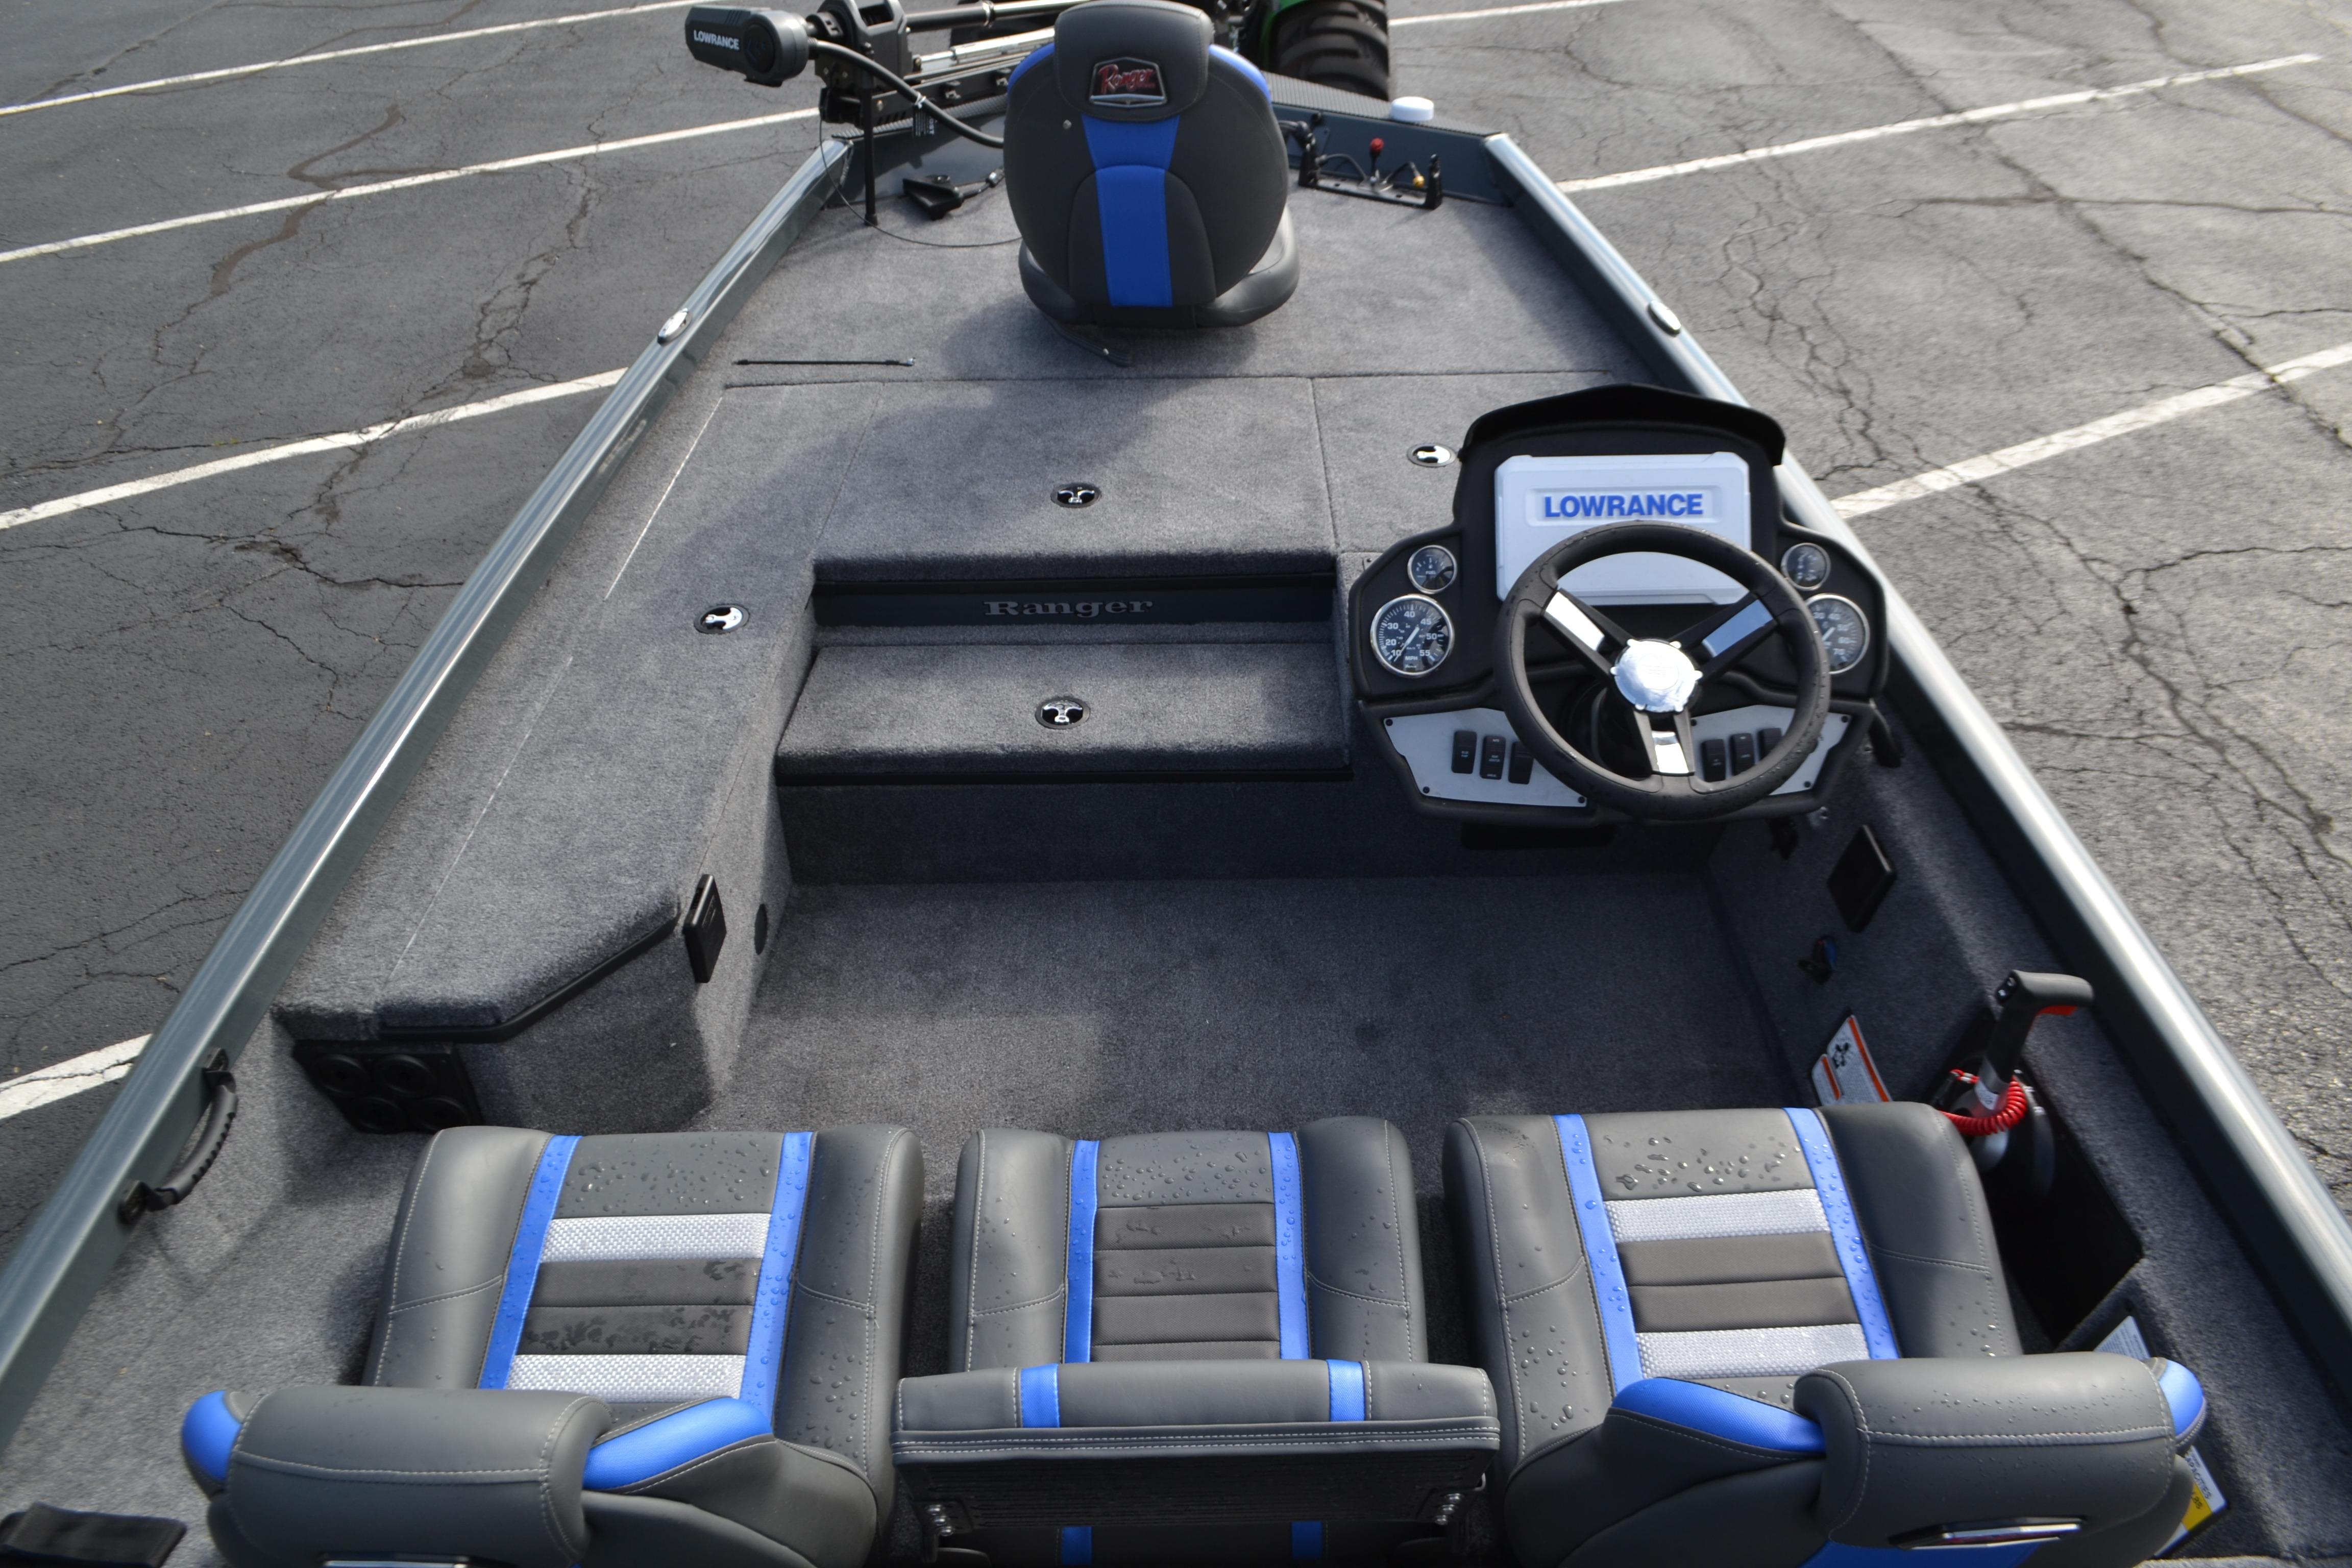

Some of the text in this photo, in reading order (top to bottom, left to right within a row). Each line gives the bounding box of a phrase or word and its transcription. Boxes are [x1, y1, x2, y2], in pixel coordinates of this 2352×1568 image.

[694, 30, 740, 50] LOWRANCE
[1098, 64, 1156, 94] Ranger
[1545, 493, 1703, 518] LOWRANCE
[984, 601, 1153, 618] Ranger
[2185, 1452, 2212, 1499] APACITIES
